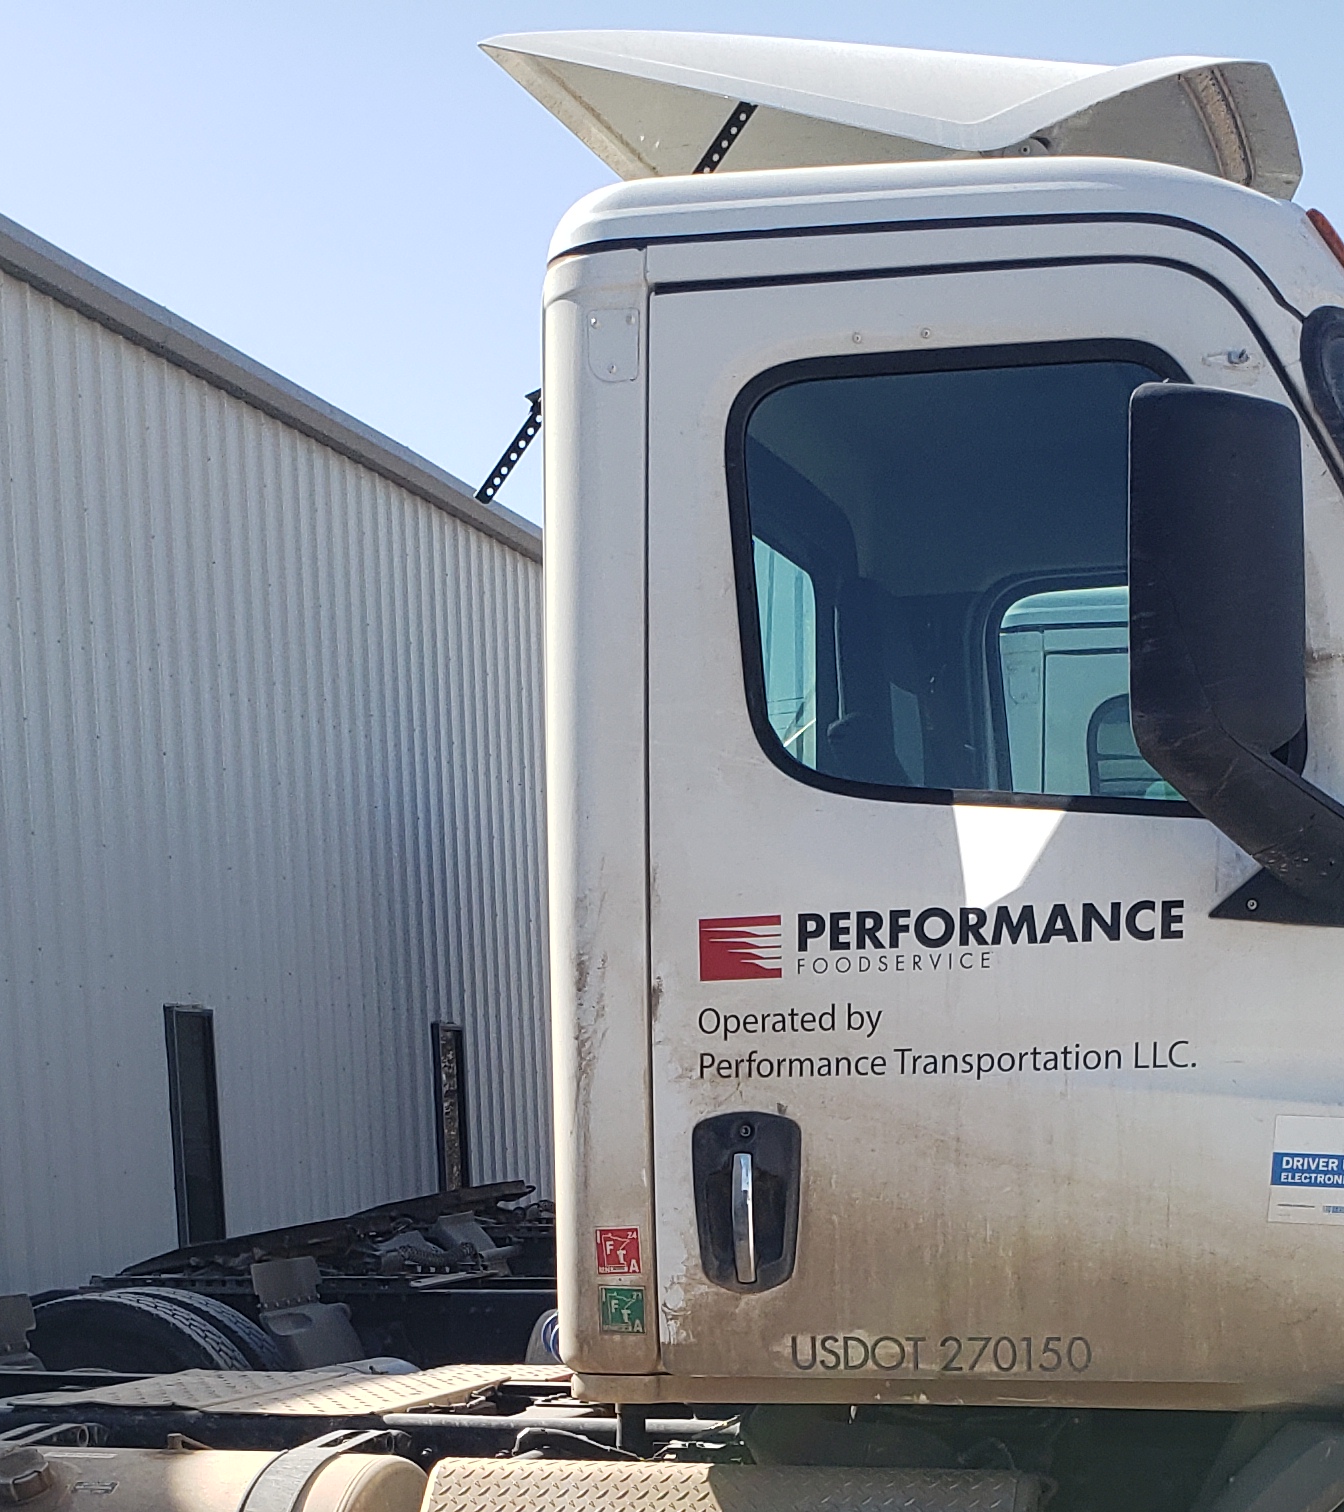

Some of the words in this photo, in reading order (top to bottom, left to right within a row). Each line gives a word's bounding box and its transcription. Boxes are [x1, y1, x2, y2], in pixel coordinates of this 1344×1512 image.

[796, 899, 1185, 952] PERFORMANCE
[796, 951, 992, 975] FOODSERVICE
[698, 1003, 836, 1041] Operated
[846, 1003, 883, 1038] by
[699, 1050, 887, 1080] Performance
[893, 1043, 1122, 1080] Transportation
[1133, 1040, 1197, 1070] LLC.
[1282, 1156, 1338, 1171] DRIVER
[790, 1335, 927, 1372] USDOT
[939, 1336, 1094, 1373] 270150
